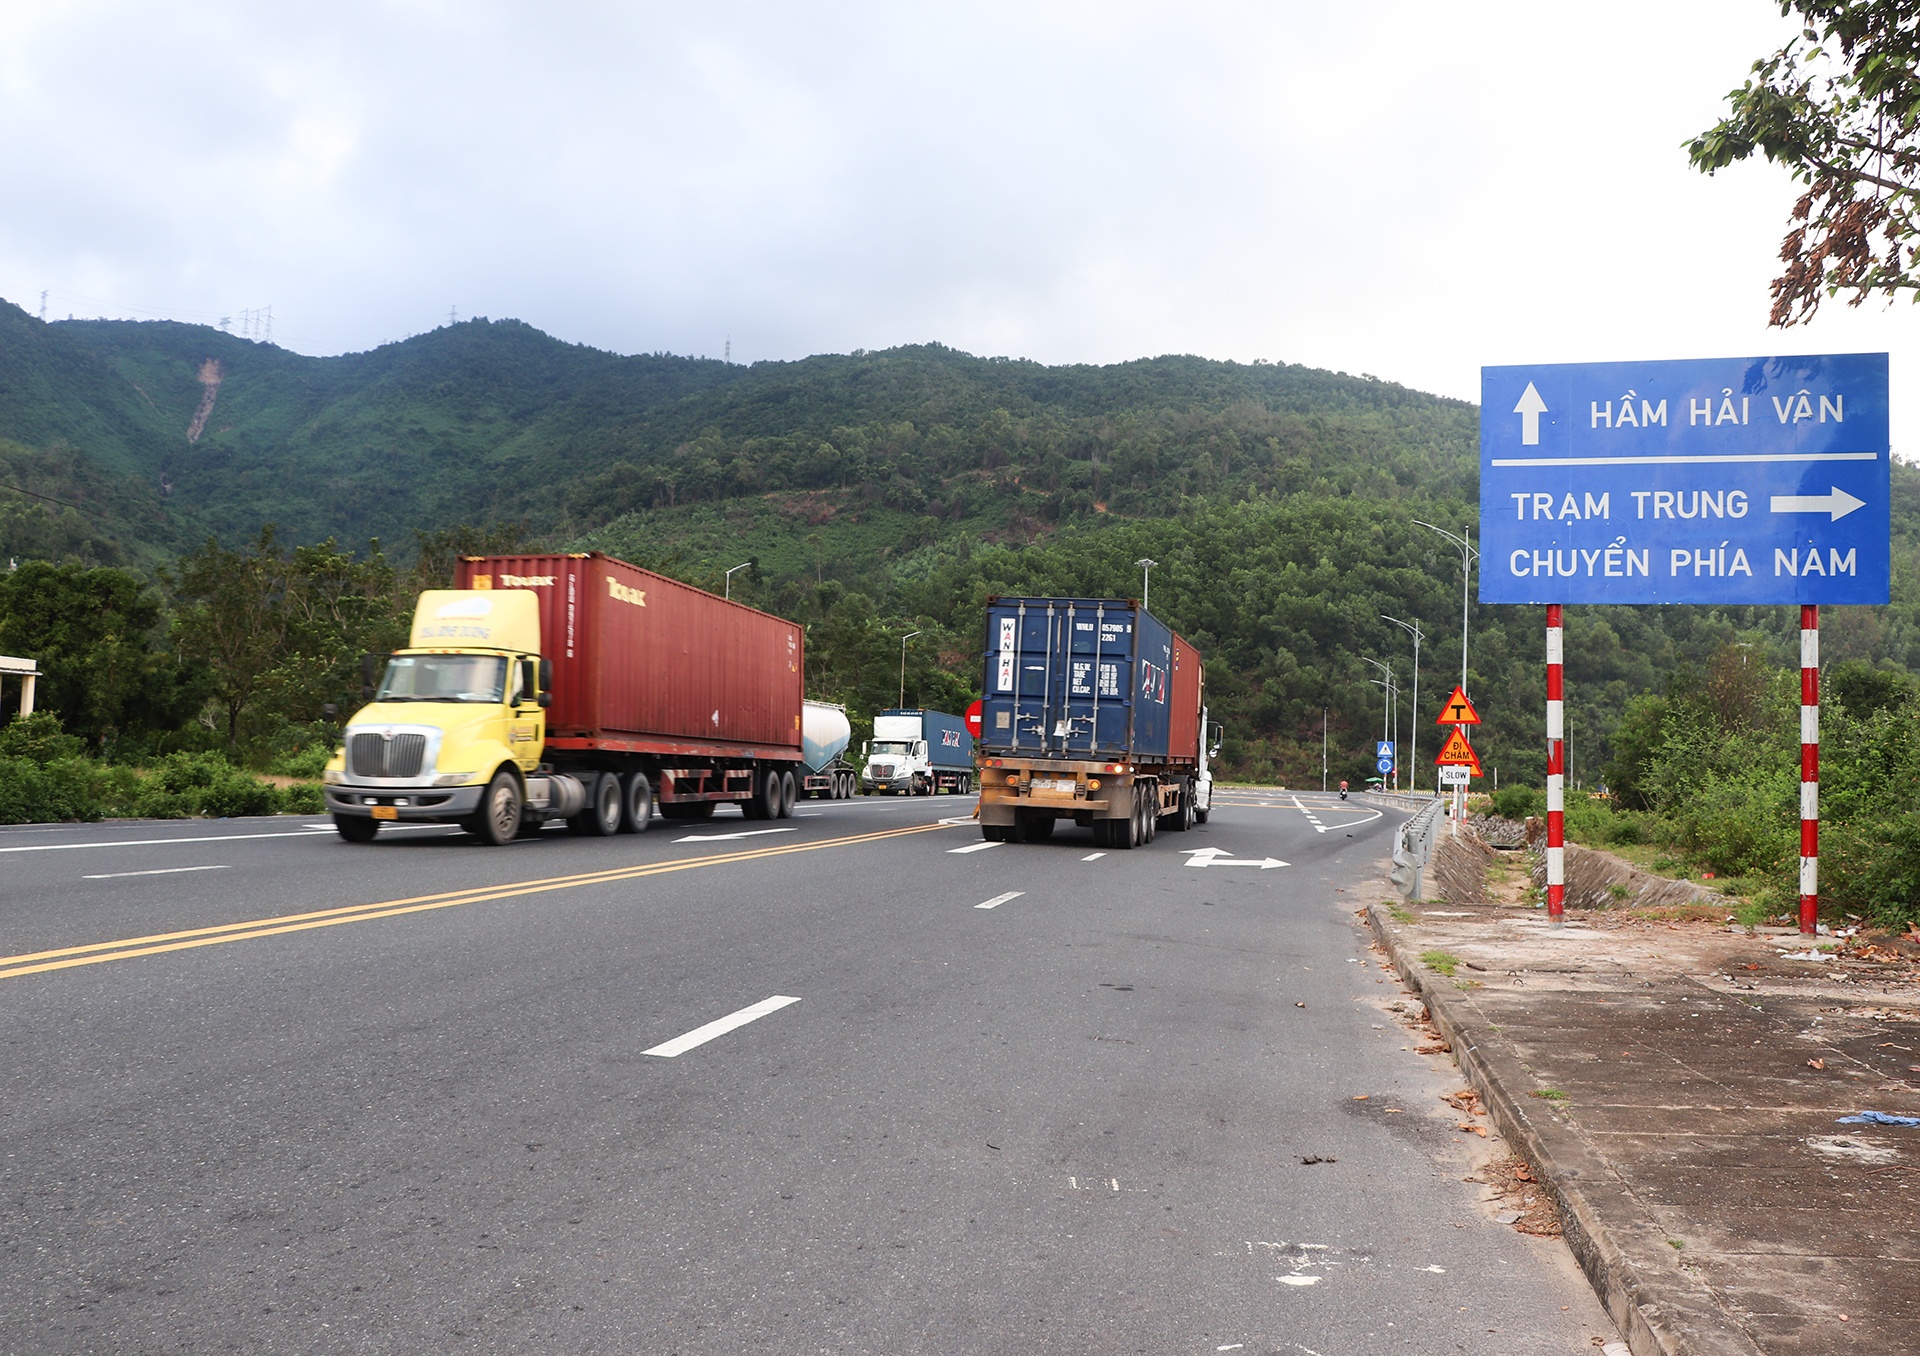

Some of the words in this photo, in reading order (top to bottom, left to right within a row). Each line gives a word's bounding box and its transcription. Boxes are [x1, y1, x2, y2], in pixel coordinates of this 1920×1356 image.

[1591, 389, 1667, 429] HẦM
[1690, 387, 1749, 426] HẢI
[1772, 389, 1843, 425] VÂN
[1511, 492, 1610, 526] TRẠM
[1631, 490, 1748, 519] TRUNG
[1510, 536, 1649, 578] CHUYỂN
[1671, 541, 1753, 577] PHÍA
[1775, 547, 1856, 577] NAM
[1453, 742, 1462, 750] ĐI
[1446, 770, 1467, 780] SLOW
